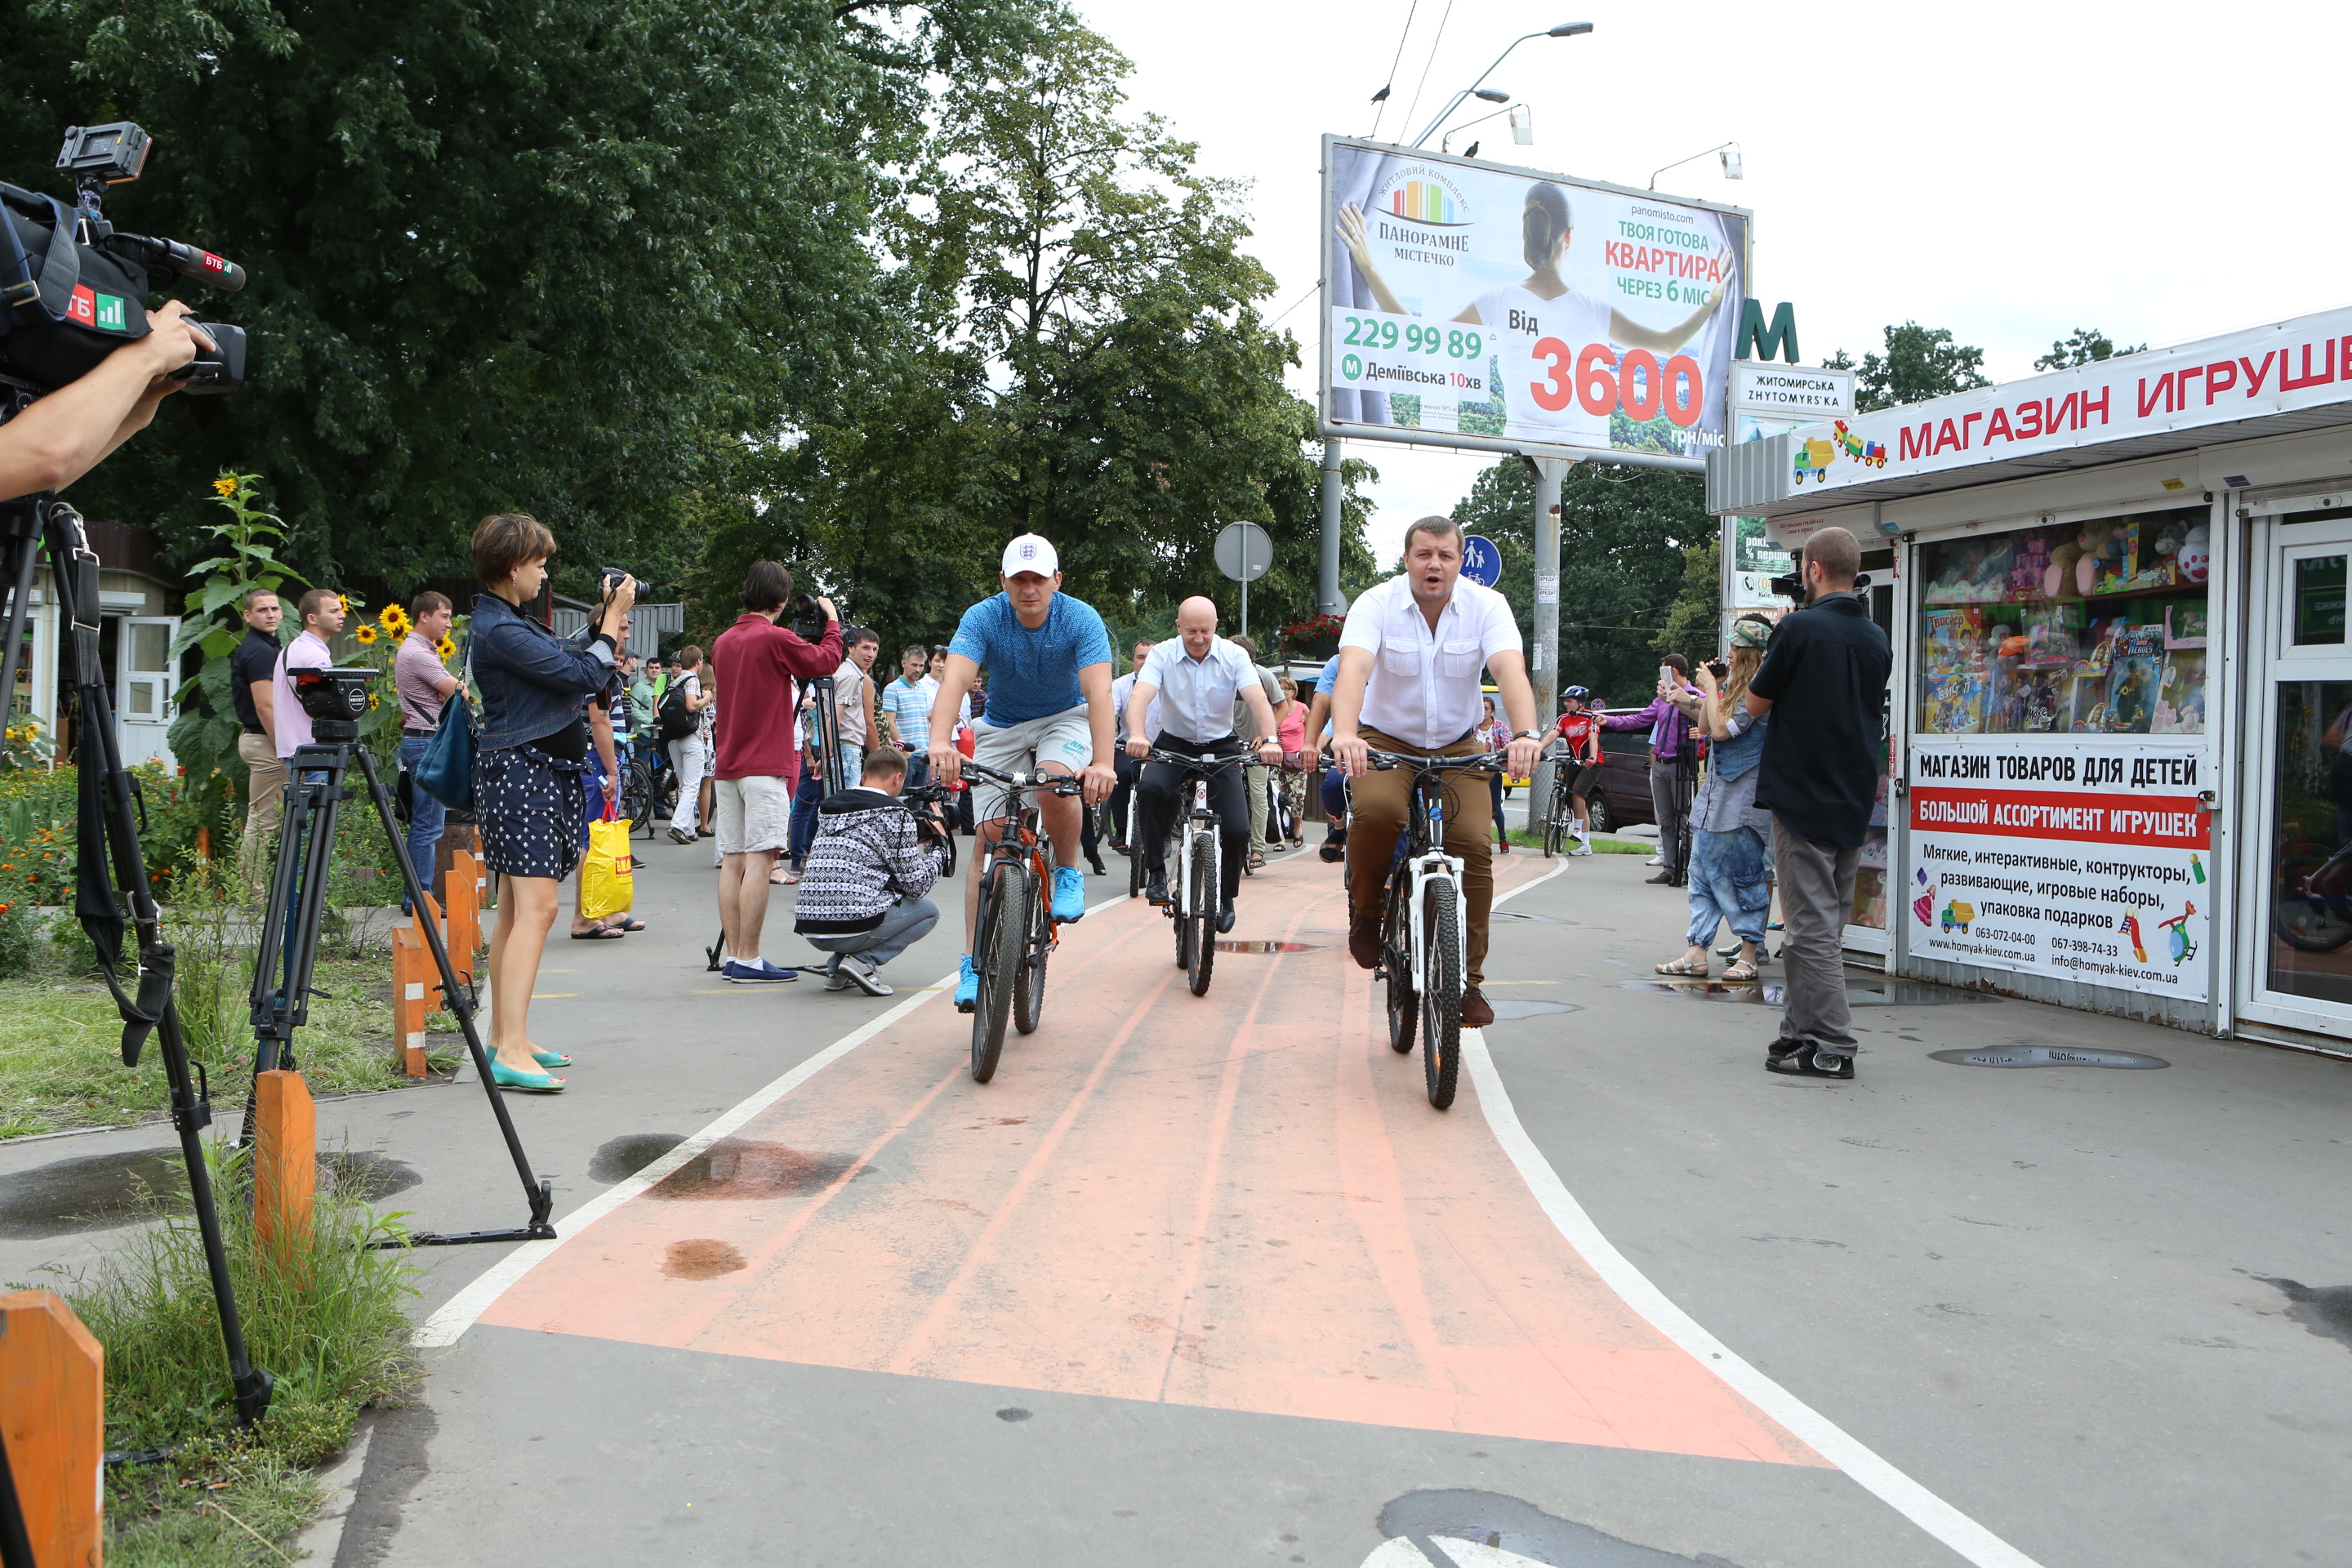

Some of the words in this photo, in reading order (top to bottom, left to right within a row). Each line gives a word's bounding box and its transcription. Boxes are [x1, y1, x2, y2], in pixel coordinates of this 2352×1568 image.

[1379, 164, 1425, 198] ЖИТЛОВИЙ
[1428, 168, 1470, 213] КОМПЛЕКС
[1631, 206, 1695, 225] panomisto.com
[1379, 221, 1469, 252] ПАНОРАМНЕ
[1619, 220, 1655, 242] ТВОЯ
[1658, 228, 1709, 252] ГОТОВА
[206, 256, 223, 270] БТБ
[1395, 247, 1454, 267] МІСТЕЧКО
[1606, 240, 1722, 283] КВАРТИРА
[1617, 276, 1662, 300] ЧЕРЕЗ
[1667, 280, 1679, 302] 6
[1682, 287, 1711, 307] МІС
[1343, 316, 1399, 350] 229
[1405, 324, 1441, 354] 99
[1447, 330, 1482, 360] 89
[1509, 310, 1539, 336] Від
[1735, 298, 1800, 363] М
[1366, 362, 1446, 385] Деміївська
[1450, 372, 1481, 390] 10хв
[1530, 336, 1704, 427] 3600
[1756, 376, 1835, 392] ЖИТОМИРСЬКА
[1748, 390, 1839, 408] ZHYTOMYRS'KA
[1671, 426, 1725, 448] грн/міс
[1900, 385, 2109, 461] МАГАЗИН
[1920, 755, 1990, 779] МАГАЗИН
[1997, 755, 2076, 782] ТОВАРОВ
[2082, 757, 2123, 786] ДЛЯ
[2131, 754, 2197, 788] ДЕТЕЙ
[1920, 799, 1989, 825] БОЛЬШОЙ
[1993, 804, 2105, 832] АССОРТИМЕНТ
[2110, 809, 2198, 838] ИГРУШЕК
[1923, 844, 1971, 865] Мягкие,
[1976, 851, 2082, 875] интерактивные,
[2087, 860, 2191, 885] контрукторы,
[1941, 871, 2033, 896] развивающие,
[2037, 881, 2096, 900] игровые
[2101, 886, 2165, 911] наборы,
[1980, 901, 2040, 920] упаковка
[2045, 908, 2113, 929] подарков
[1929, 938, 2035, 963] www.homyak-kiev.com.ua
[1976, 927, 2036, 946] 063-072-04-00
[2051, 937, 2118, 957] 067-398-74-33
[2051, 954, 2178, 985] info@homyak-kiev.com.ua
